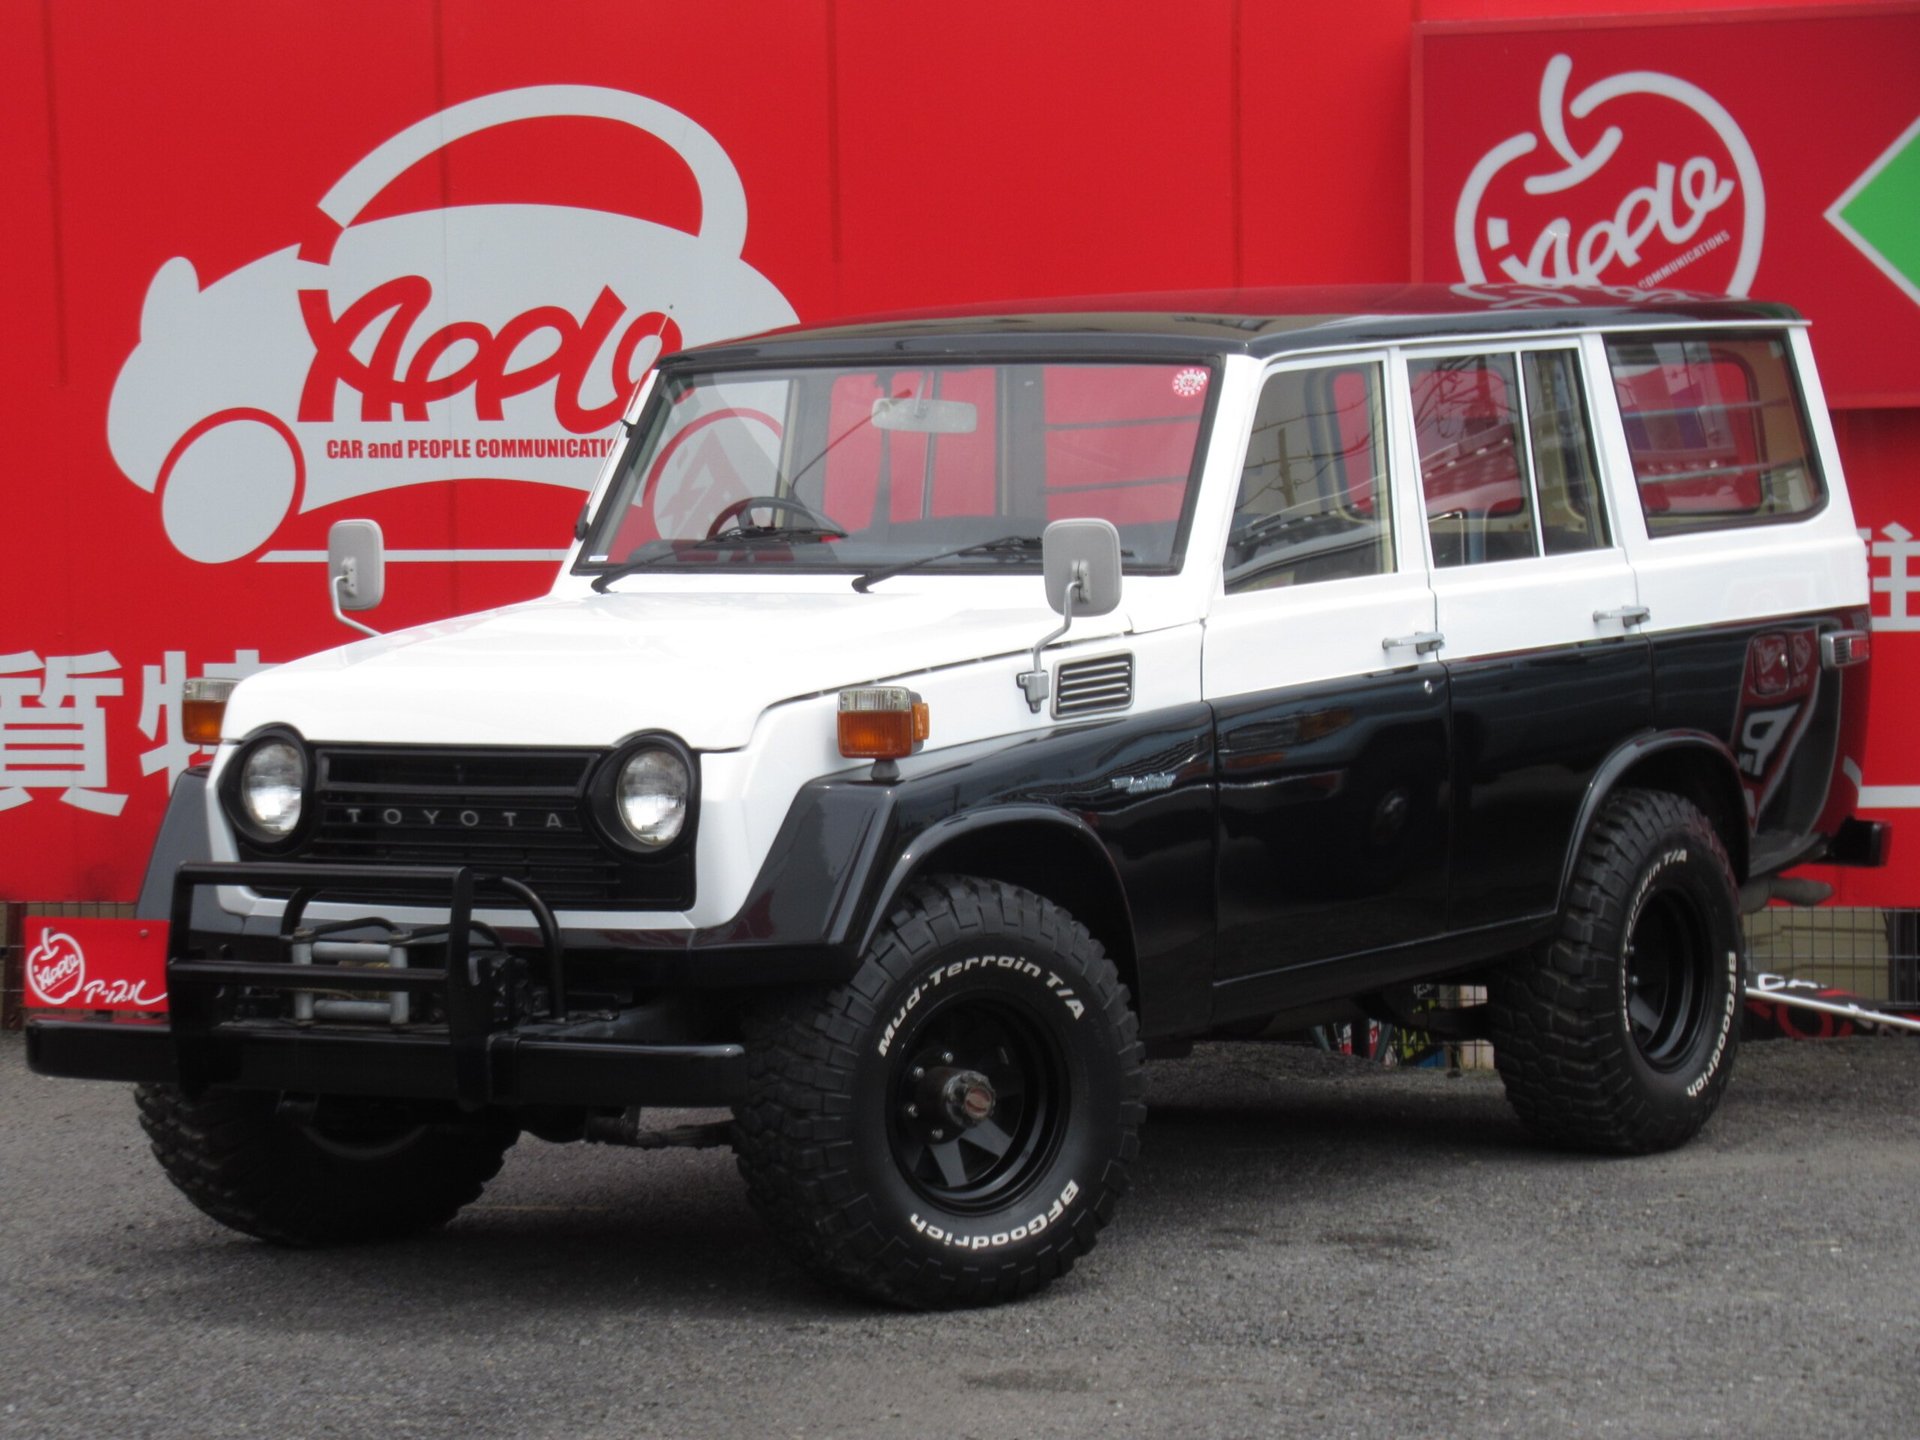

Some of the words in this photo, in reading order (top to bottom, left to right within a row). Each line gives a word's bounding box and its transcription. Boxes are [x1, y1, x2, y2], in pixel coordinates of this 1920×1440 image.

[327, 439, 363, 459] CAR
[367, 439, 403, 459] and
[407, 438, 472, 459] PEOPLE
[347, 807, 562, 829] TOYOTA
[878, 954, 1041, 1058] Mud-Terrain
[1046, 970, 1087, 1023] T/A
[1687, 951, 1737, 1098] BFGoodrich
[909, 1178, 1080, 1251] BFGoodrich
